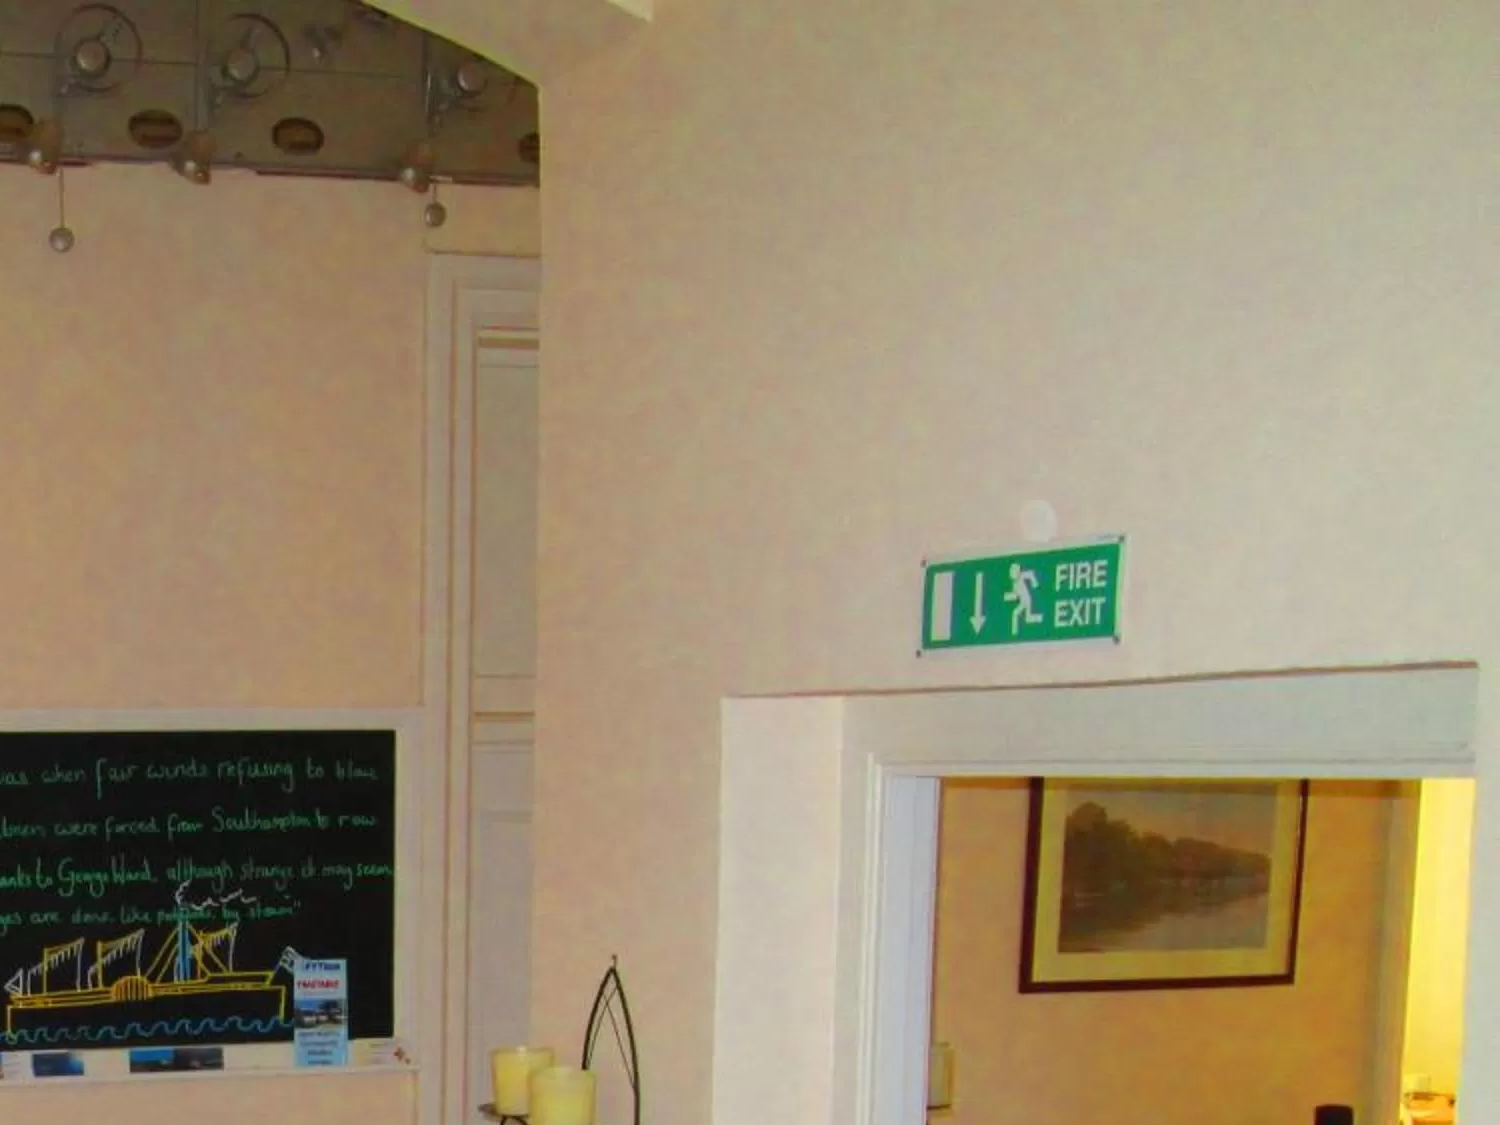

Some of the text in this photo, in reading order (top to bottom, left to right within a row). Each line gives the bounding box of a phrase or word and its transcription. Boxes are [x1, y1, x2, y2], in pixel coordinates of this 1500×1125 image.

[1055, 559, 1109, 592] FIRE
[1053, 597, 1107, 629] EXIT
[41, 761, 87, 784] when
[216, 757, 294, 794] refusing
[306, 756, 325, 779] to
[53, 821, 97, 837] were
[104, 815, 160, 842] forced
[167, 812, 204, 842] from
[313, 807, 330, 829] to
[338, 813, 377, 829] row
[36, 856, 54, 889] to
[166, 855, 234, 893] although
[320, 864, 354, 892] may
[29, 911, 61, 925] are
[120, 905, 152, 925] like
